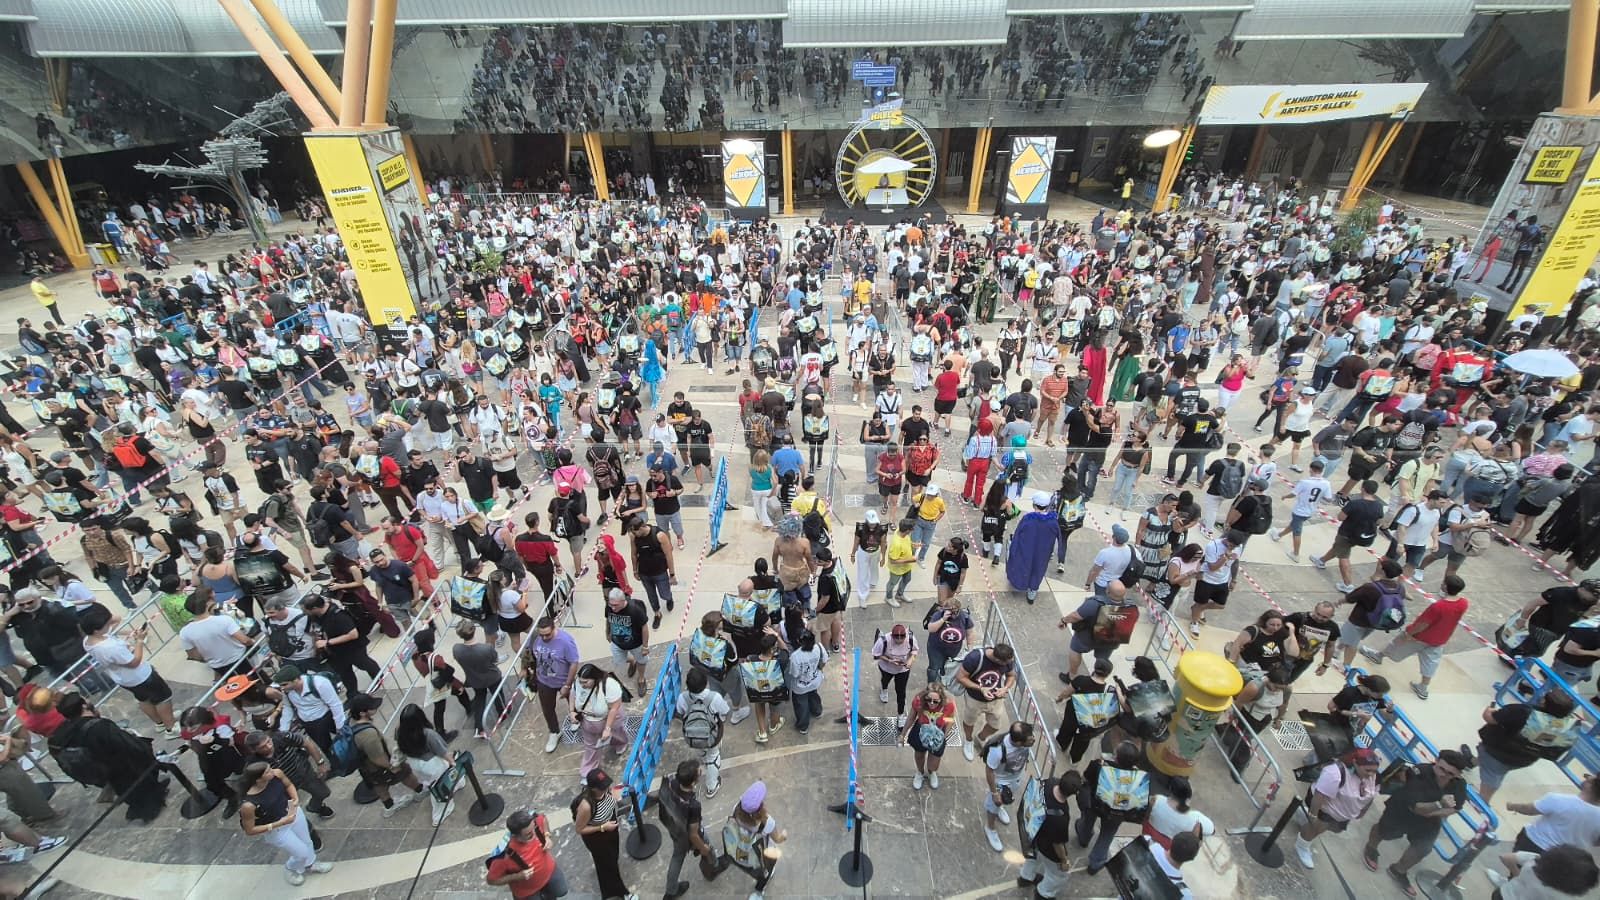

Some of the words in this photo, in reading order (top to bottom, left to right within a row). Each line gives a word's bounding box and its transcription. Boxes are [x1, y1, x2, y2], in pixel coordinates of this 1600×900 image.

[1284, 93, 1334, 105] EXHIBITOR
[1335, 90, 1358, 99] HALL
[1280, 103, 1322, 115] ARTISTS'
[1321, 101, 1352, 110] ALLEY
[1543, 150, 1575, 158] COSPLAY
[1538, 160, 1546, 168] IS
[1546, 160, 1561, 168] NOT
[1534, 169, 1565, 177] CONSENT
[1308, 487, 1322, 502] 9
